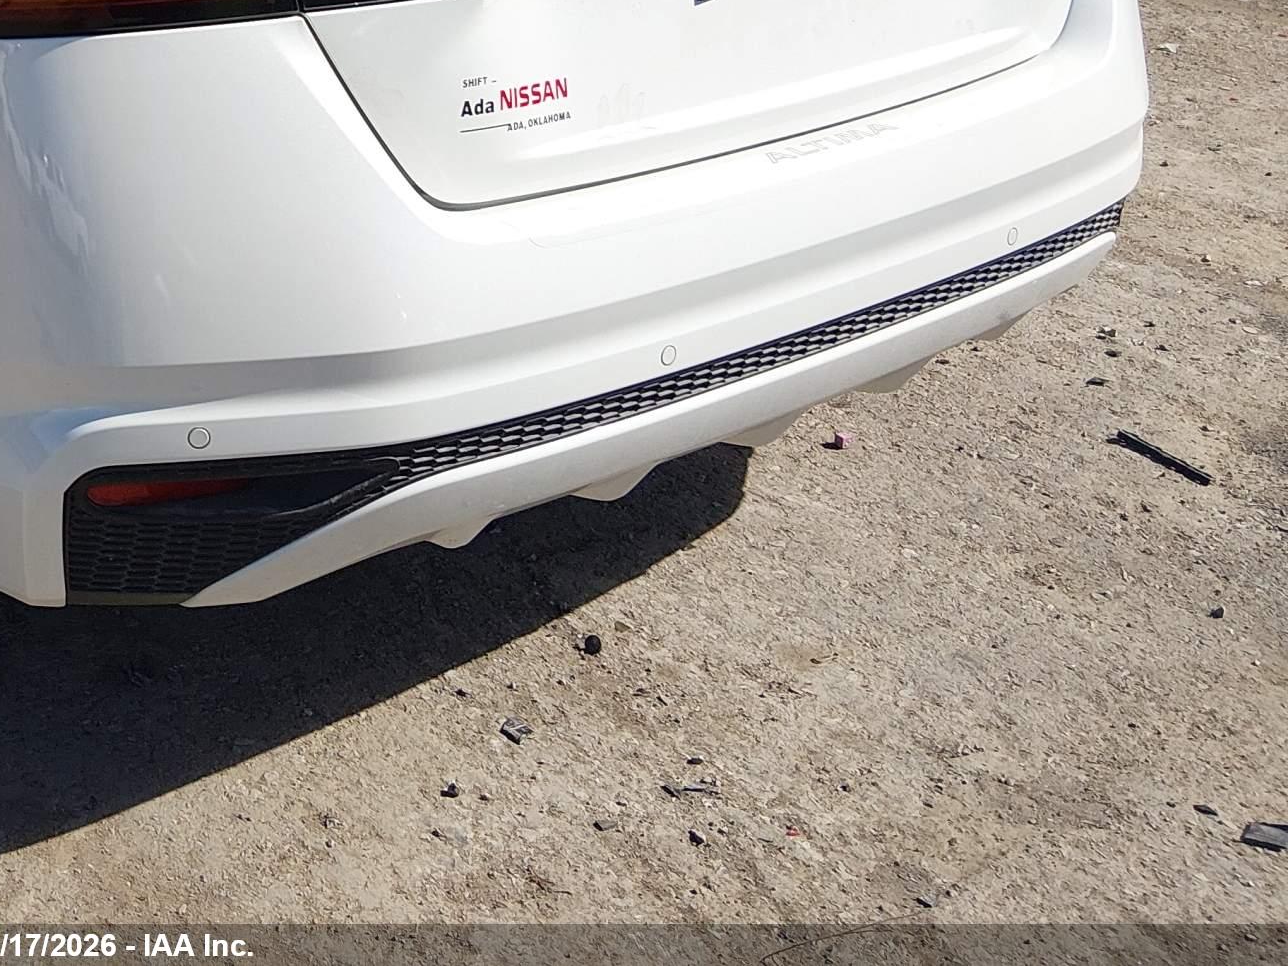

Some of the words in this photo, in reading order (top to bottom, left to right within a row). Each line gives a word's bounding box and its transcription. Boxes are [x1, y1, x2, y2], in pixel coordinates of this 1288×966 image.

[460, 97, 495, 117] Ada
[499, 77, 569, 111] NISSAN
[462, 76, 488, 89] SHIFT
[506, 120, 527, 132] ADA,
[527, 111, 572, 128] OKLAHOMA
[765, 122, 900, 164] ALTIMA
